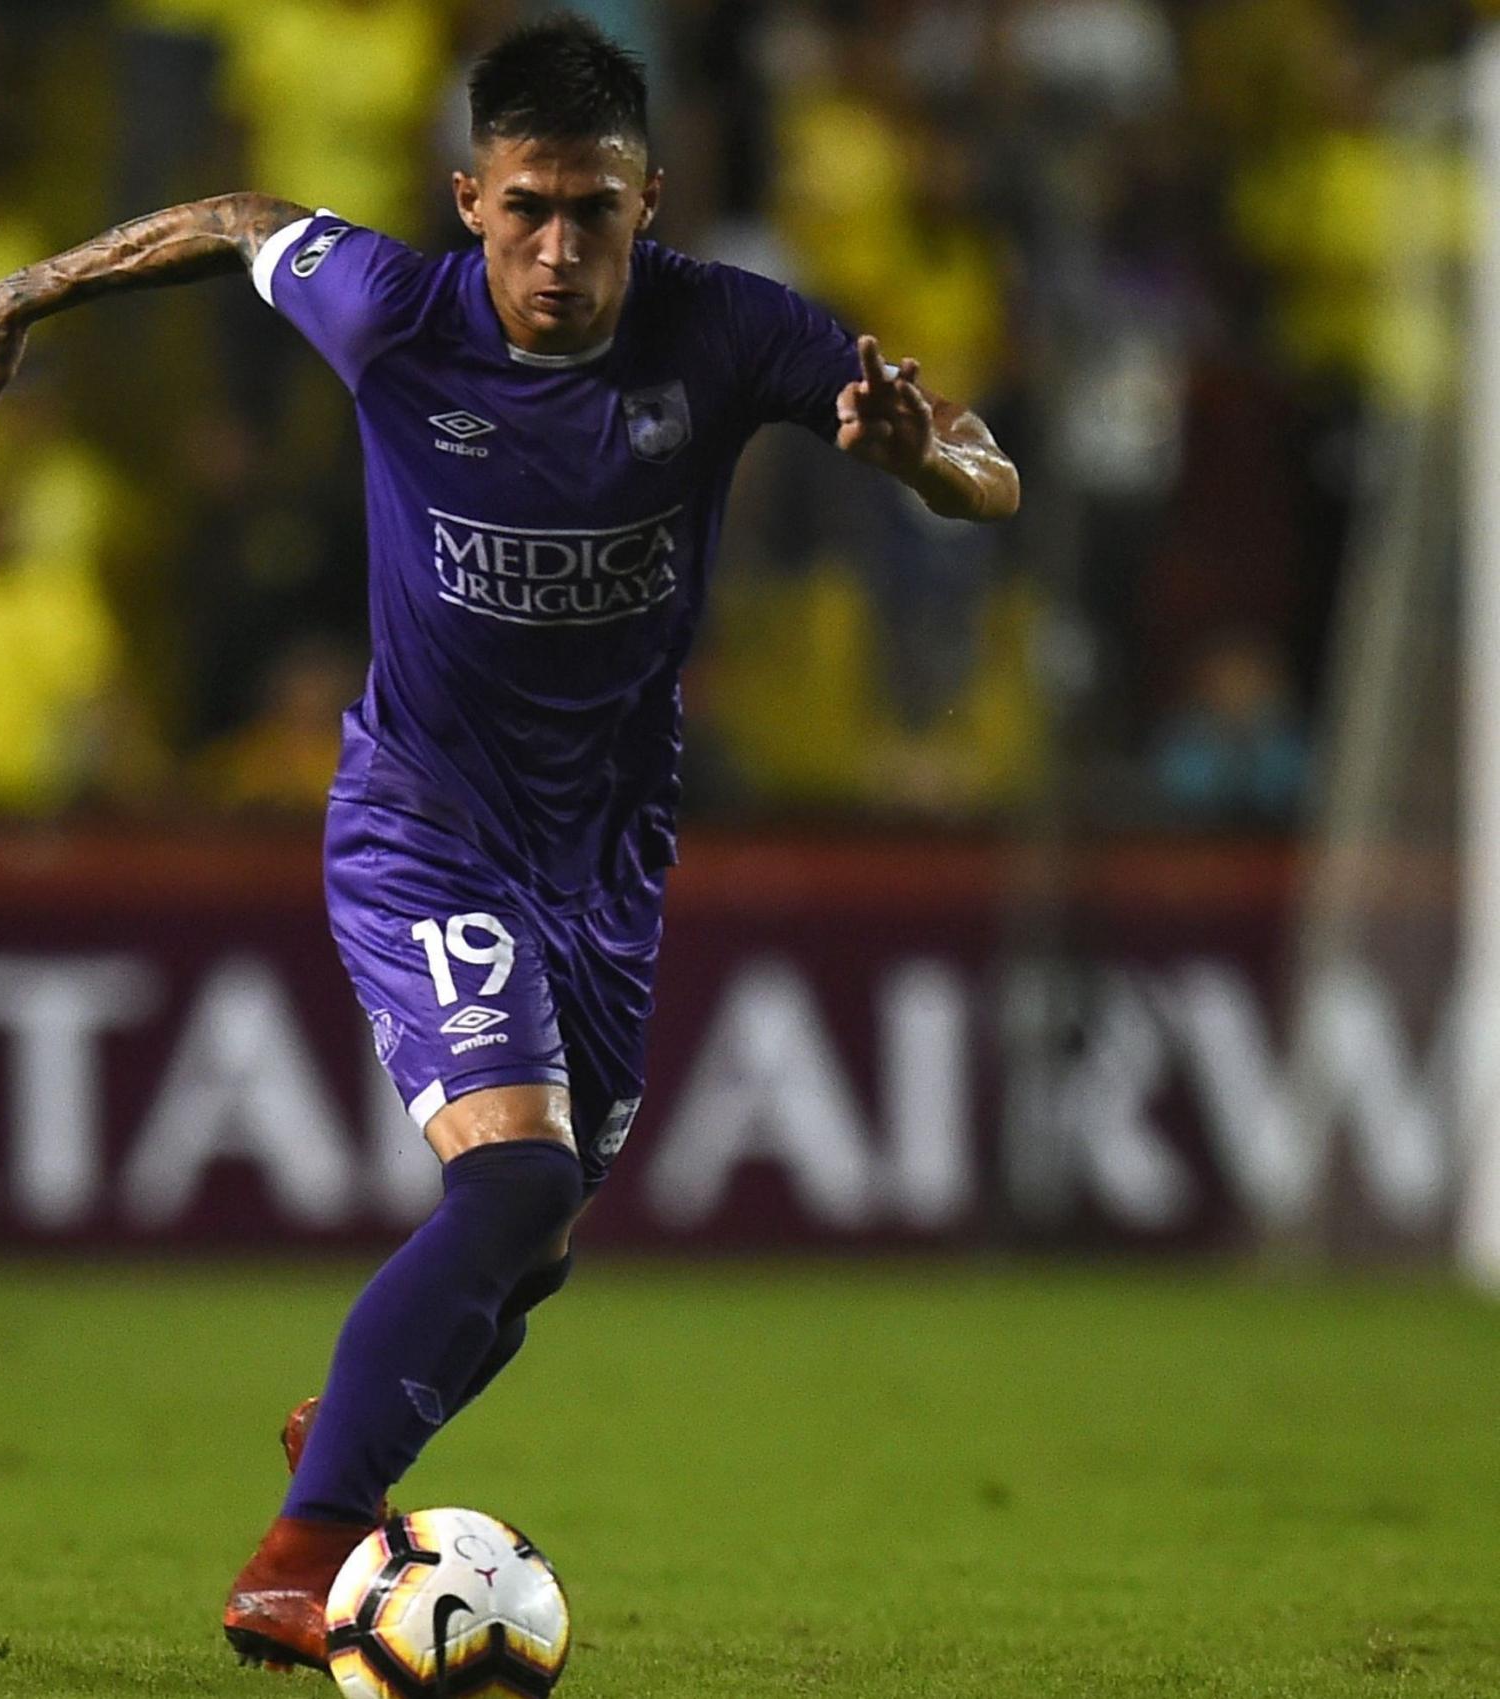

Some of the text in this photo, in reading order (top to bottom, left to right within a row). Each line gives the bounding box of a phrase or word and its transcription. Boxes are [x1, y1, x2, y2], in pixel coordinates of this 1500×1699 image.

[434, 437, 489, 458] umbro
[433, 521, 676, 581] MEDICA
[410, 911, 516, 1007] 19
[451, 1032, 509, 1056] umbro
